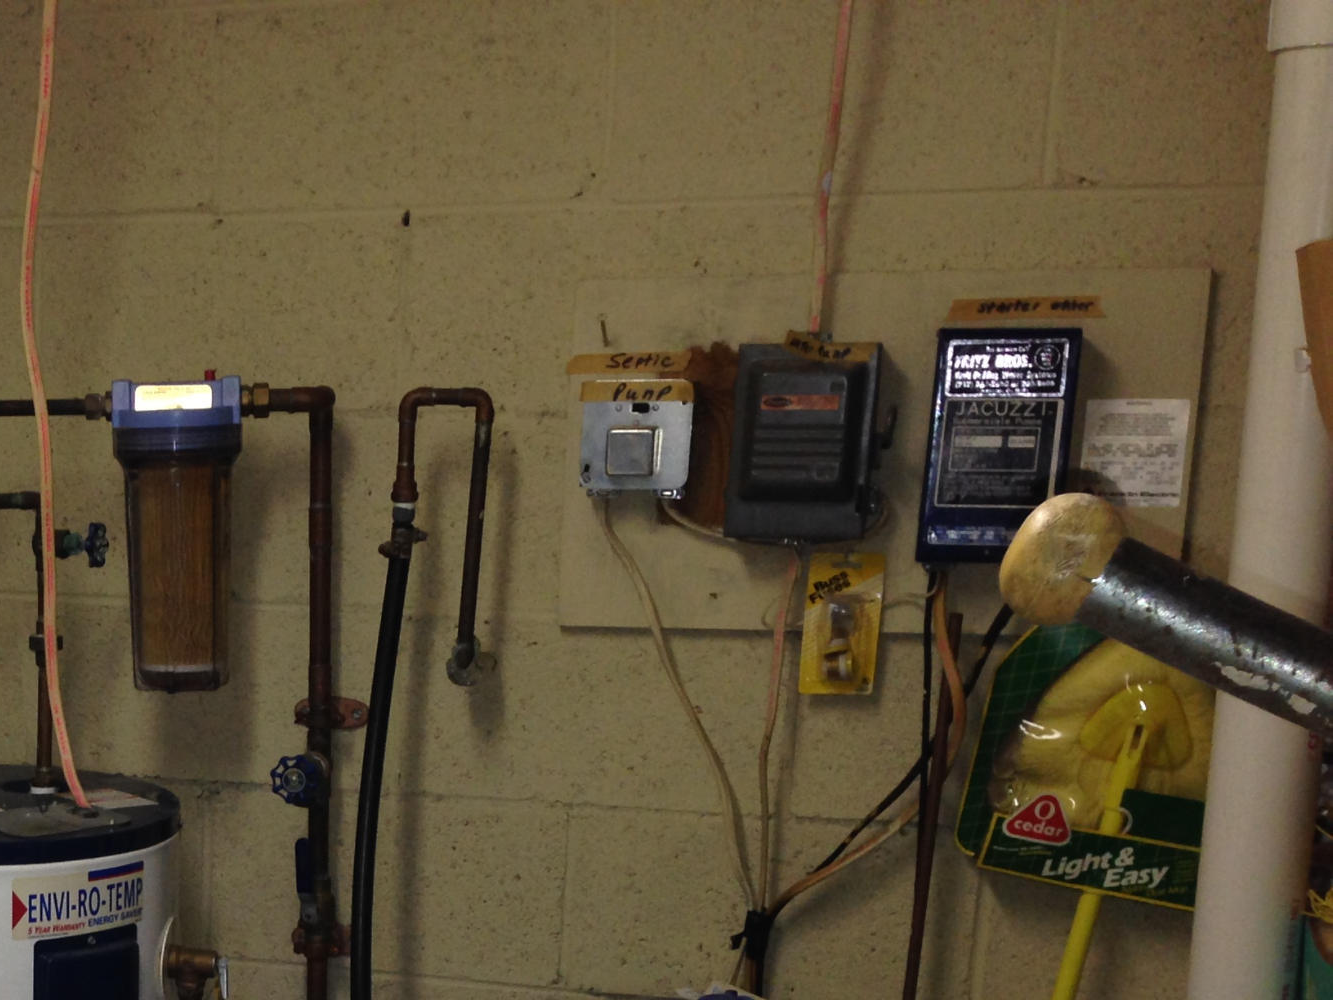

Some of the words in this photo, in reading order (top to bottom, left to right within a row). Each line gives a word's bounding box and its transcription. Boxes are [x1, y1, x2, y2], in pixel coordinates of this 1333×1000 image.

[606, 353, 675, 369] Septic
[1034, 800, 1056, 821] O
[1013, 819, 1064, 838] cedar
[1041, 851, 1113, 880] Light
[1114, 846, 1136, 868] &
[1102, 865, 1171, 889] Easy
[27, 878, 144, 924] ENVI-RO-TEMP
[34, 926, 52, 935] YEAR
[88, 914, 119, 928] ENERGY
